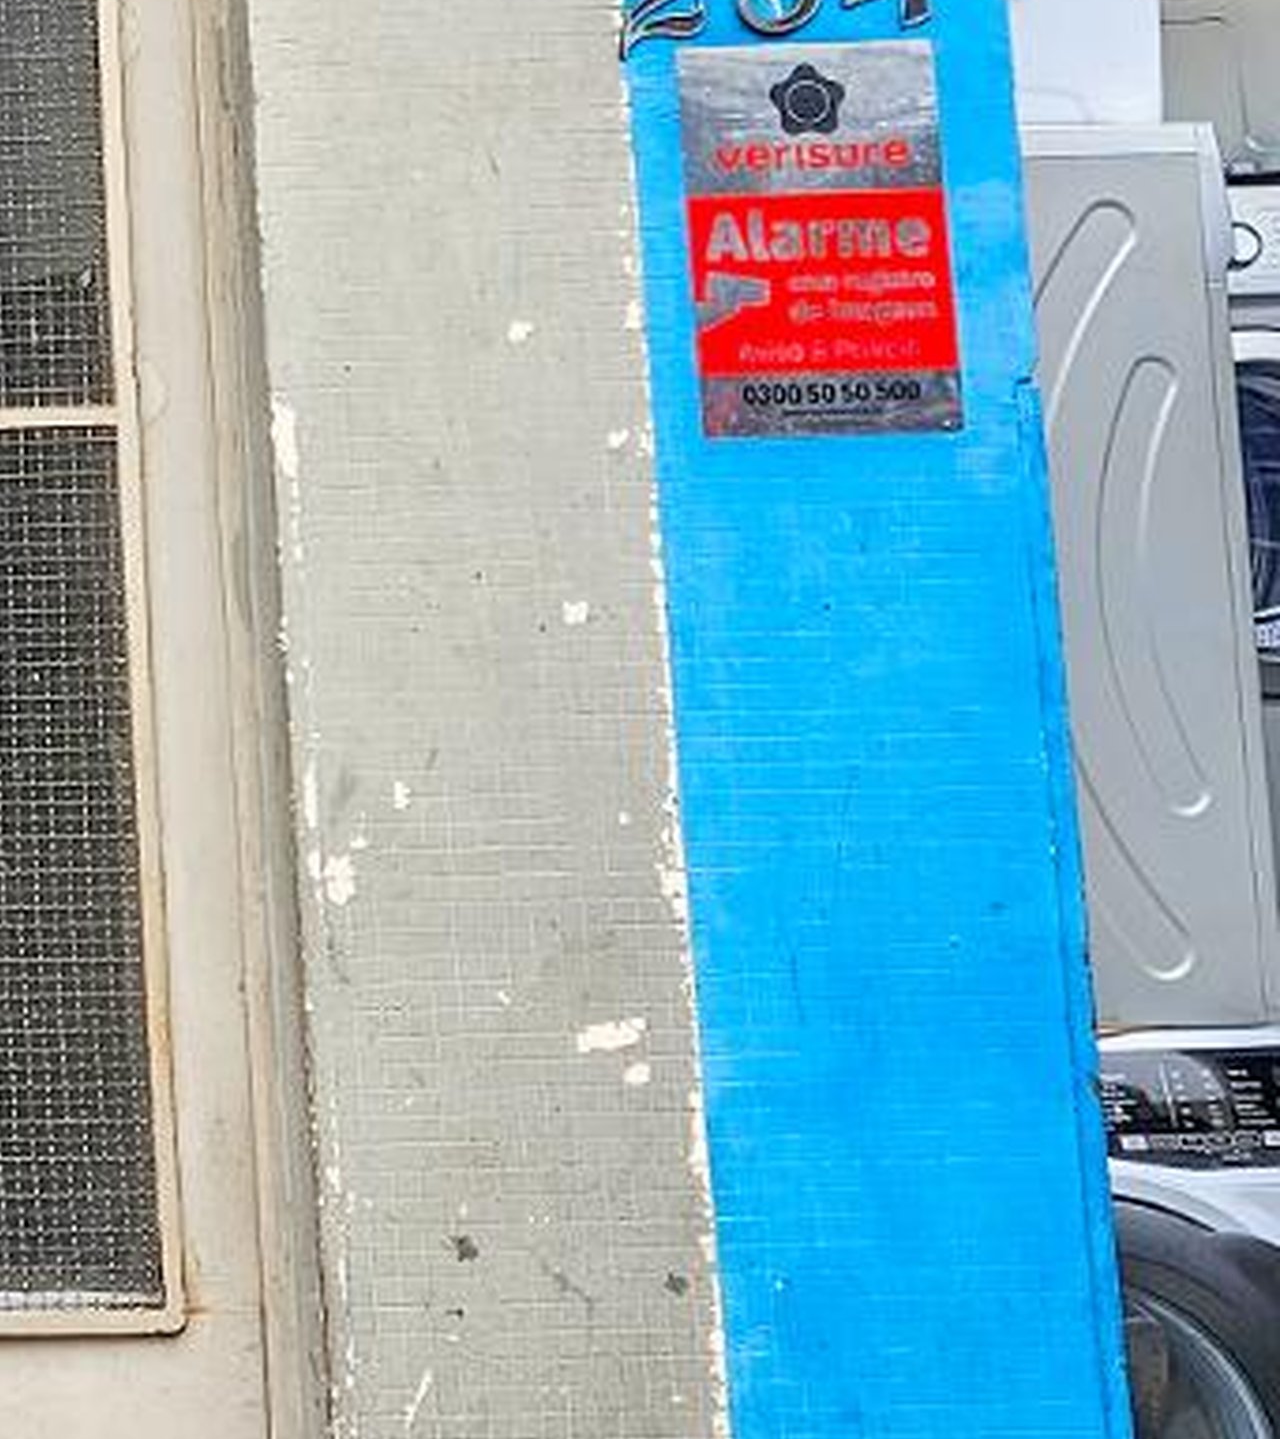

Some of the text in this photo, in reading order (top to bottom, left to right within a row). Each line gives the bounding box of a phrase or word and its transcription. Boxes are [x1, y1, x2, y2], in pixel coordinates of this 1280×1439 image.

[715, 138, 909, 171] verisure
[705, 208, 932, 262] Alarme
[742, 381, 802, 406] 0300
[806, 382, 836, 405] 50
[874, 378, 922, 402] 500
